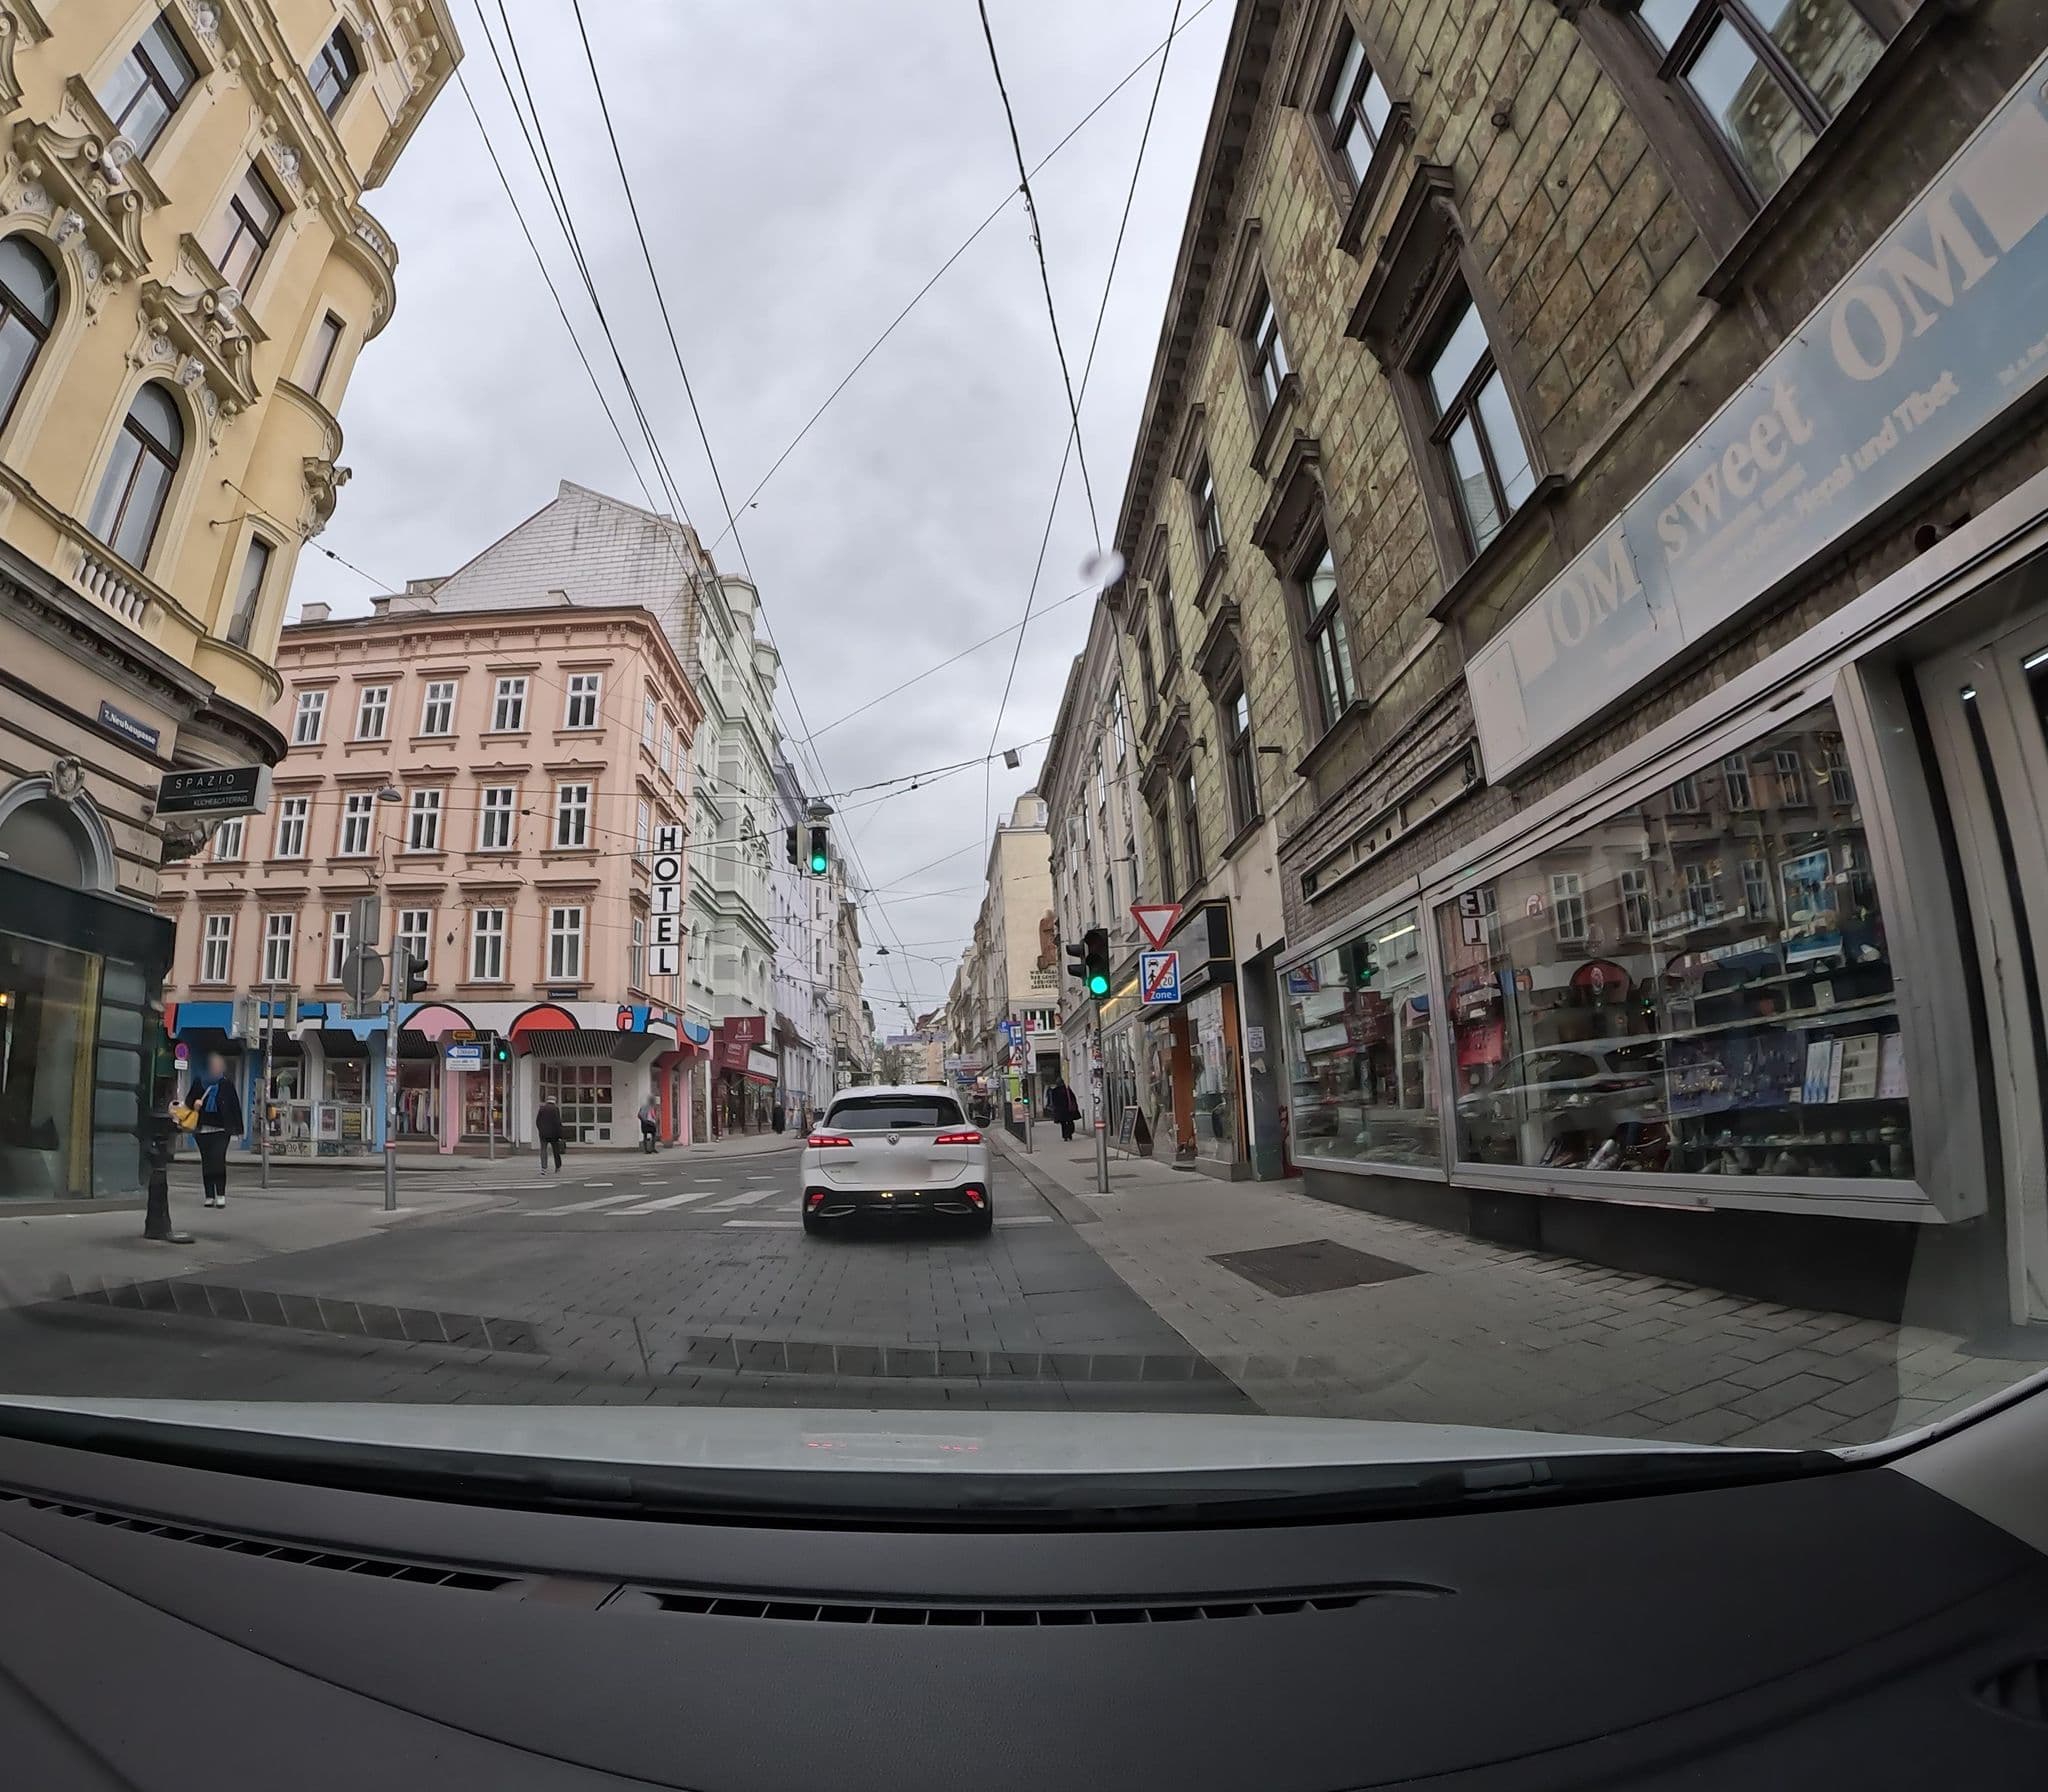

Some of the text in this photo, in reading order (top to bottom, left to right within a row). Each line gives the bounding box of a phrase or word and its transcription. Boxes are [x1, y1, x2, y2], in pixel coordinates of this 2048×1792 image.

[1657, 375, 1814, 561] sweet
[1831, 193, 2000, 381] OM
[175, 774, 235, 789] SPAZIO
[654, 827, 679, 974] HOTEL
[1163, 976, 1173, 986] 20
